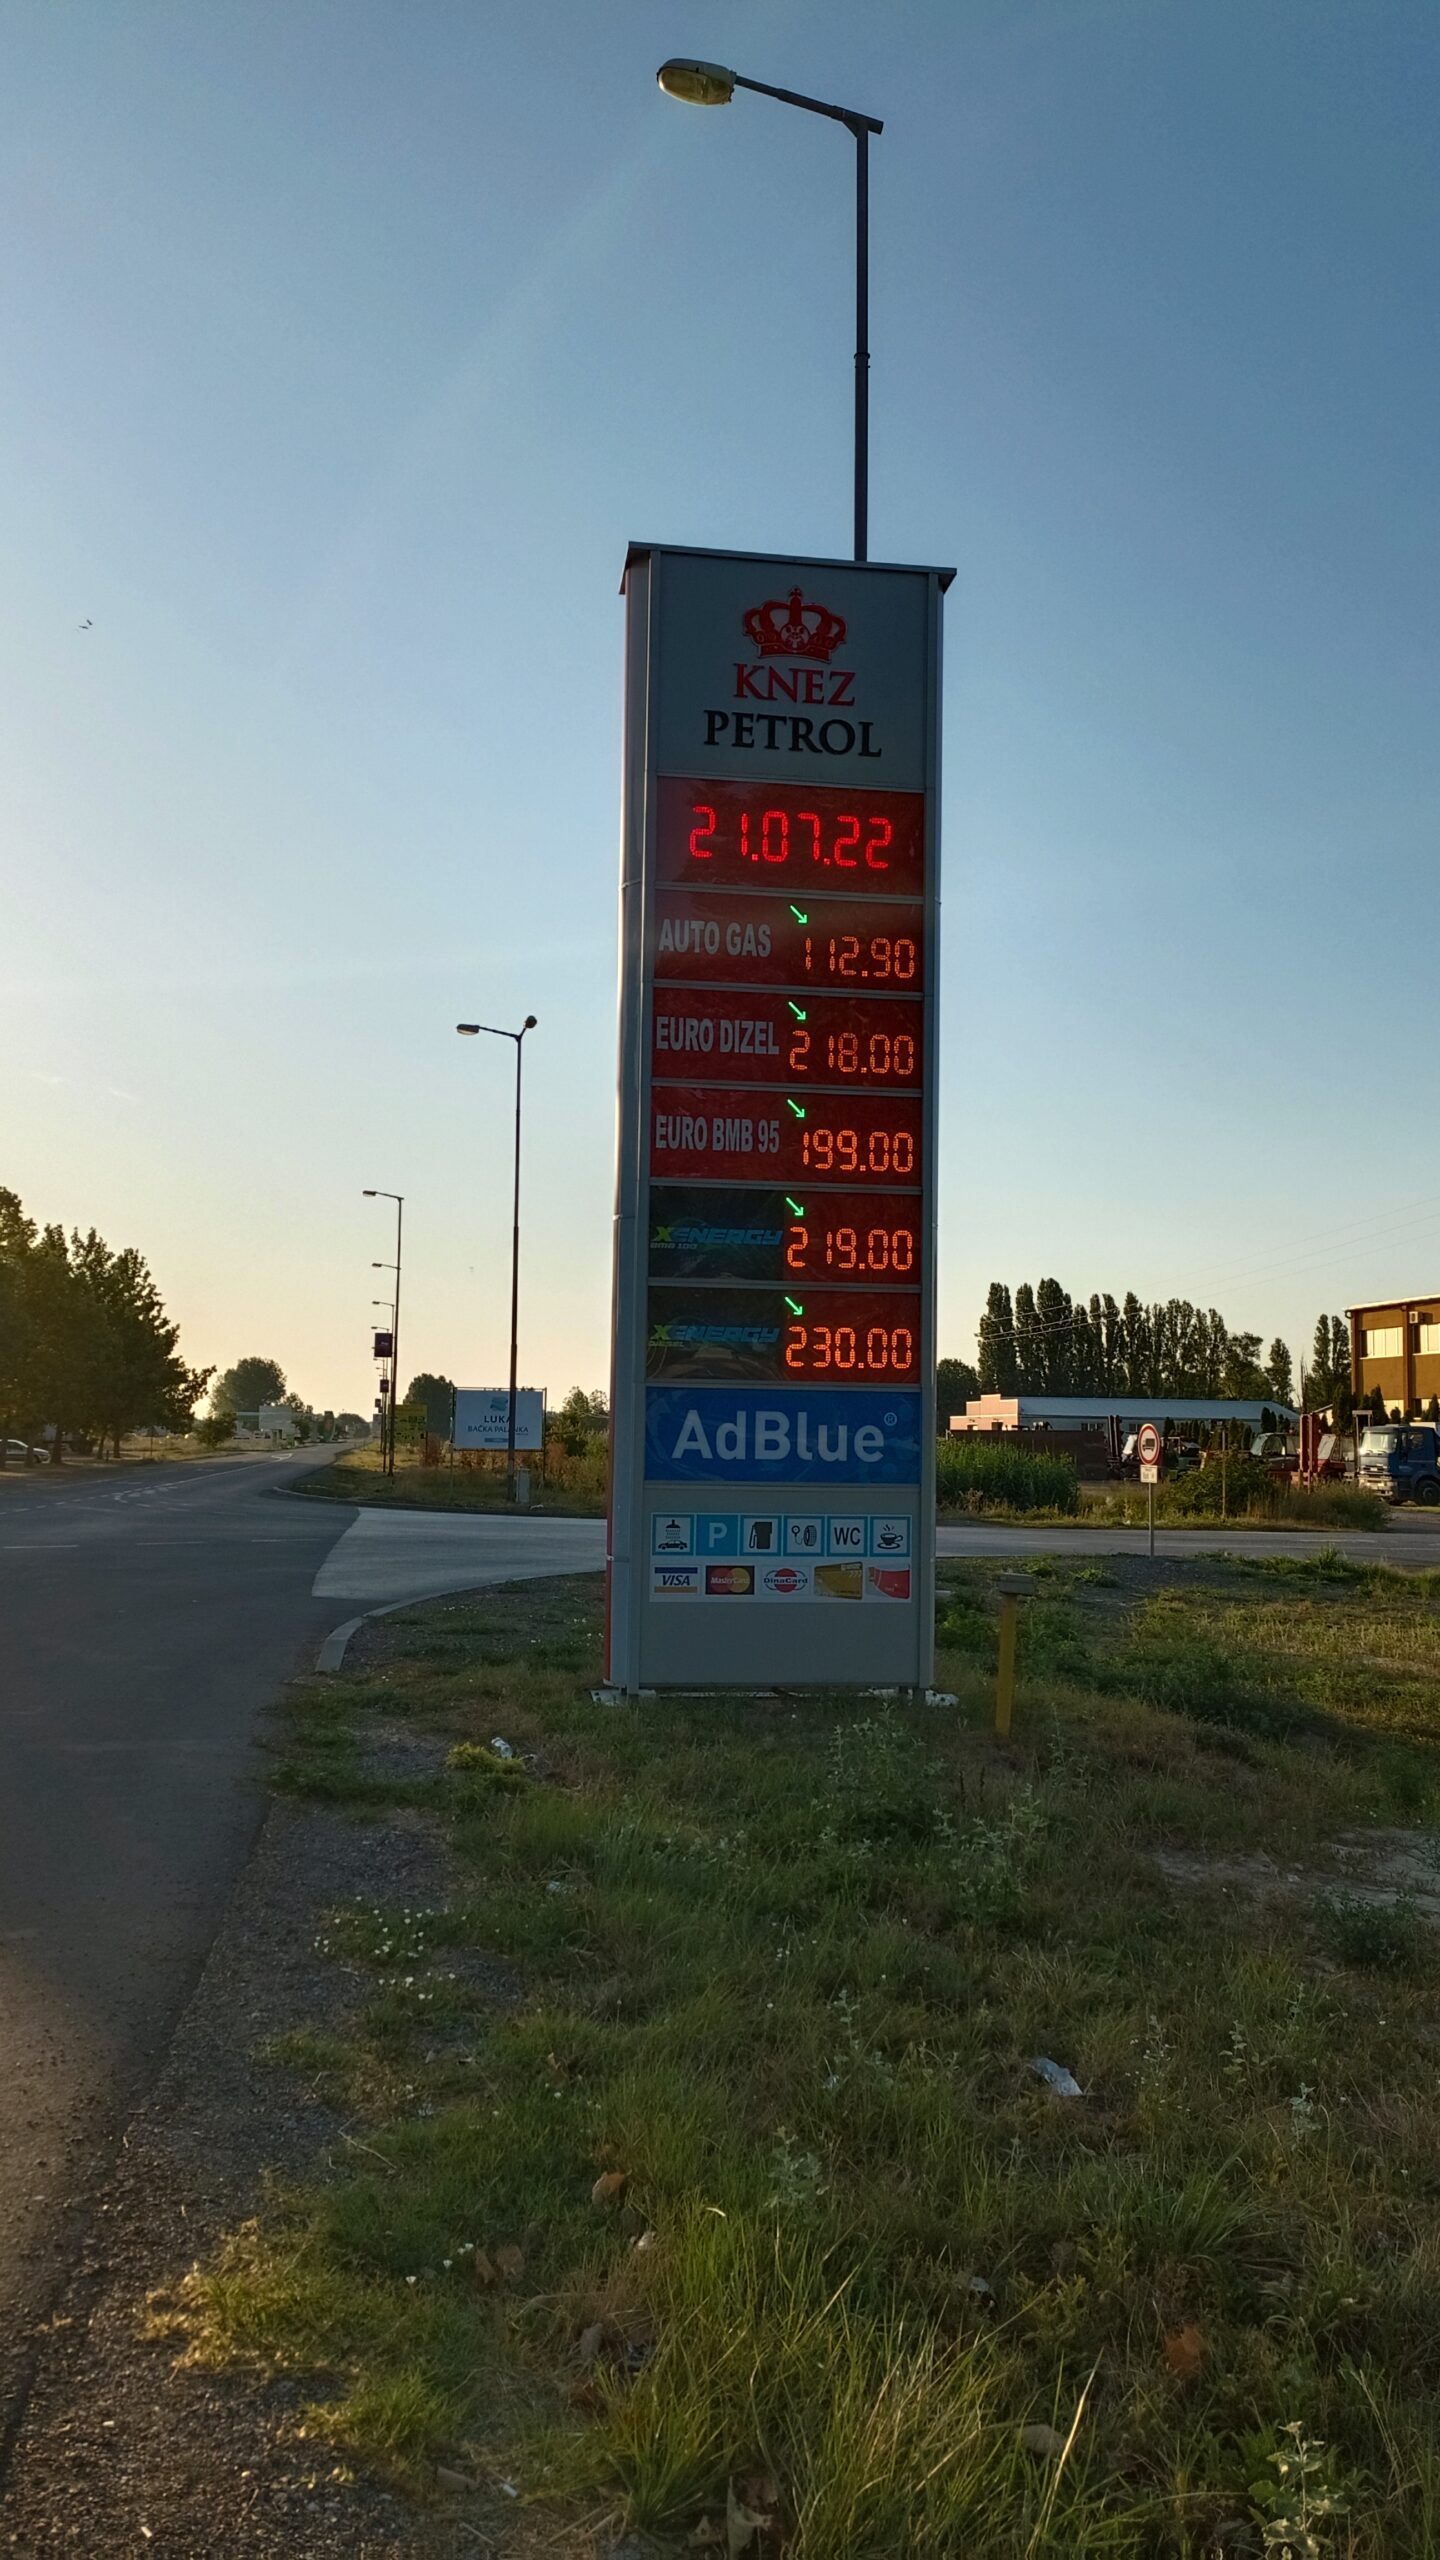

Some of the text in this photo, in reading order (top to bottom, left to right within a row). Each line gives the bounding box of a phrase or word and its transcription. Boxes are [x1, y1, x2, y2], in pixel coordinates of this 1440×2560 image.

[733, 662, 856, 707] KNEZ
[703, 709, 883, 758] PETROL
[689, 806, 893, 869] 21.07.22
[658, 918, 772, 957] AUTO GAS
[804, 936, 916, 979] 112.90
[656, 1016, 780, 1055] EURO DIZEL
[655, 1115, 780, 1153] EURO BMB 95
[803, 1129, 914, 1173] 199.00
[652, 1226, 783, 1246] XENERGY
[785, 1326, 912, 1369] 230.00
[495, 1425, 529, 1433] PALNKA
[708, 1522, 728, 1548] P
[834, 1526, 861, 1546] WC
[661, 1574, 691, 1587] VISA
[763, 1576, 808, 1585] DinaCard
